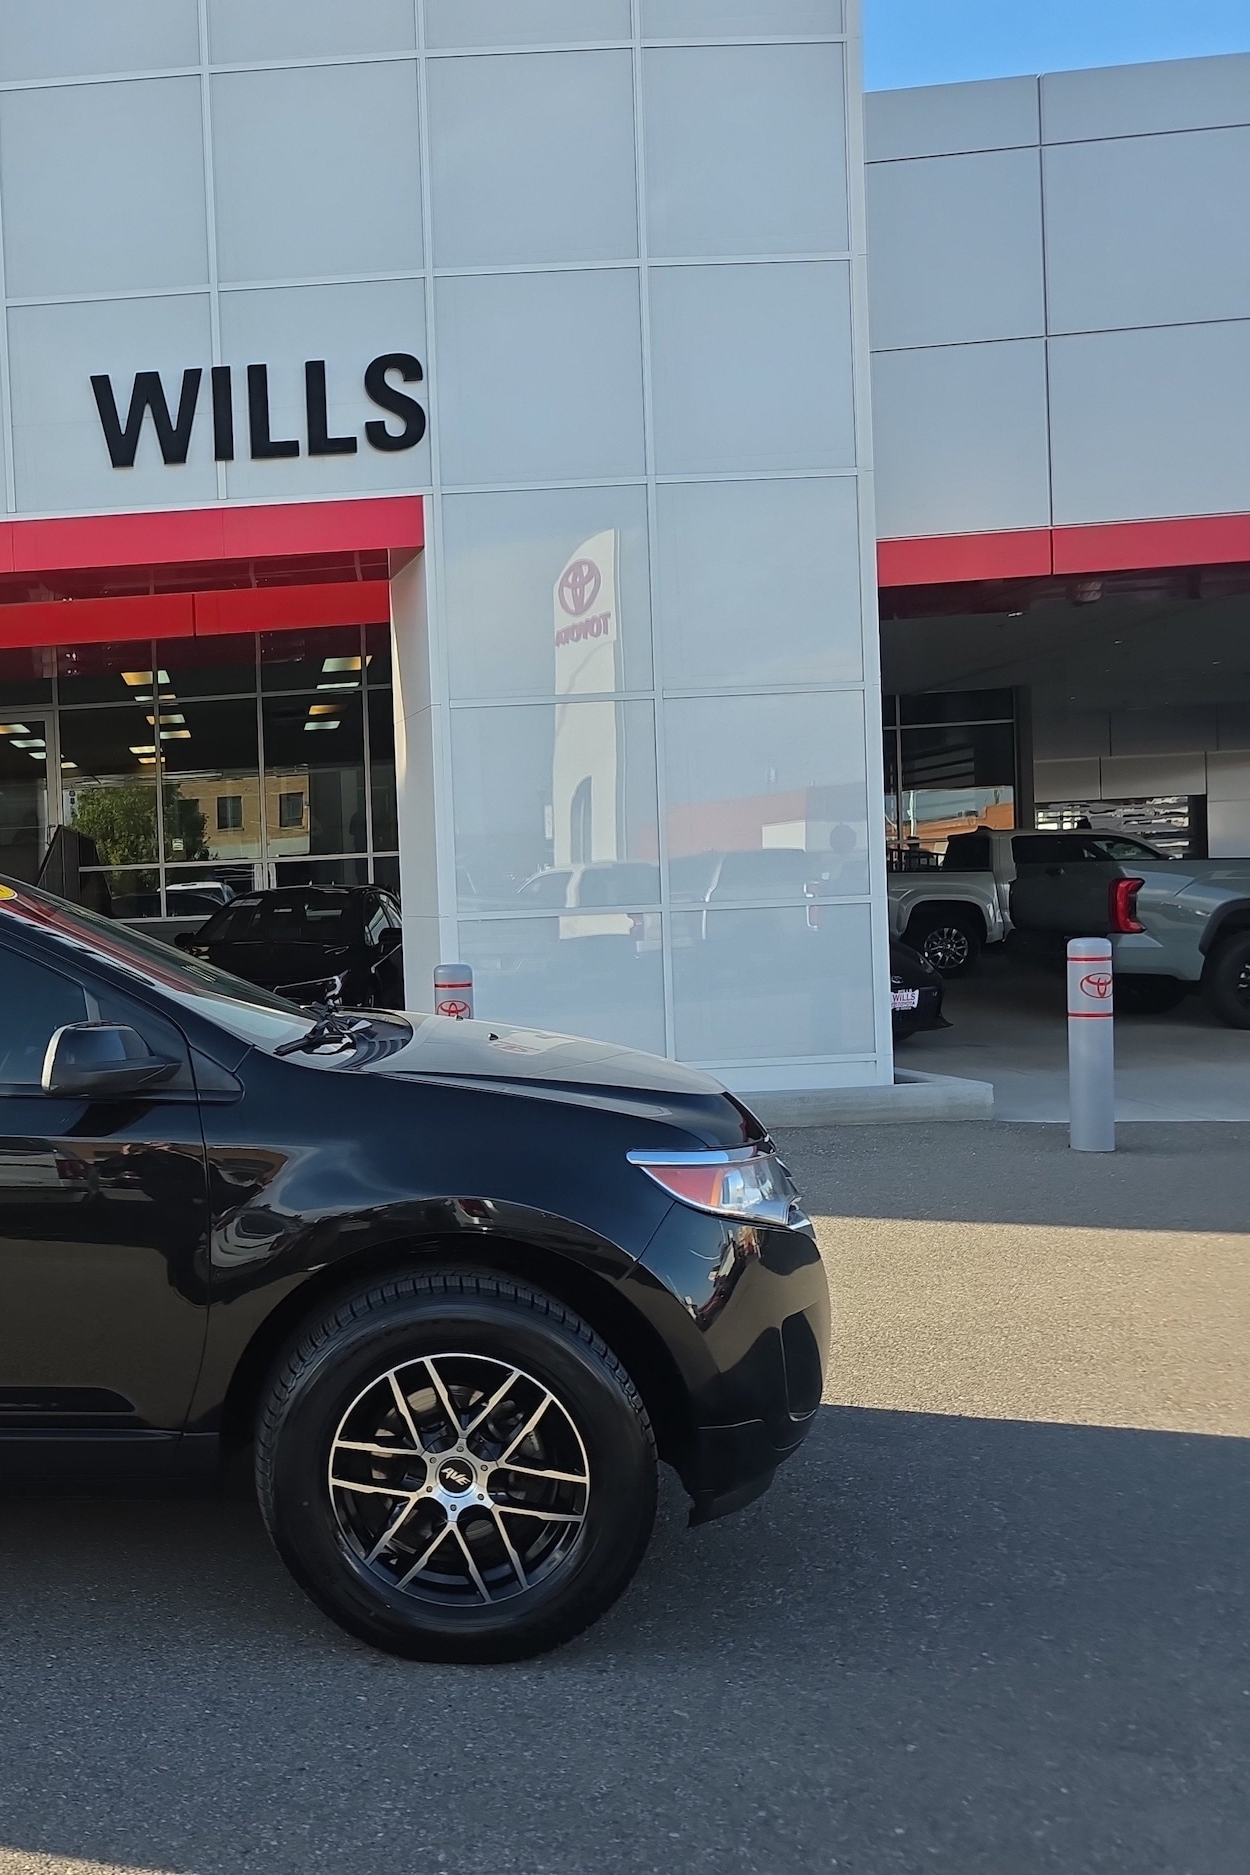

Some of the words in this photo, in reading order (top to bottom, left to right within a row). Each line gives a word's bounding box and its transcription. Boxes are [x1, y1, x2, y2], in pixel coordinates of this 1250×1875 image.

[90, 352, 426, 468] WILLS
[892, 993, 916, 1002] WILLS
[441, 1467, 472, 1486] AVE
